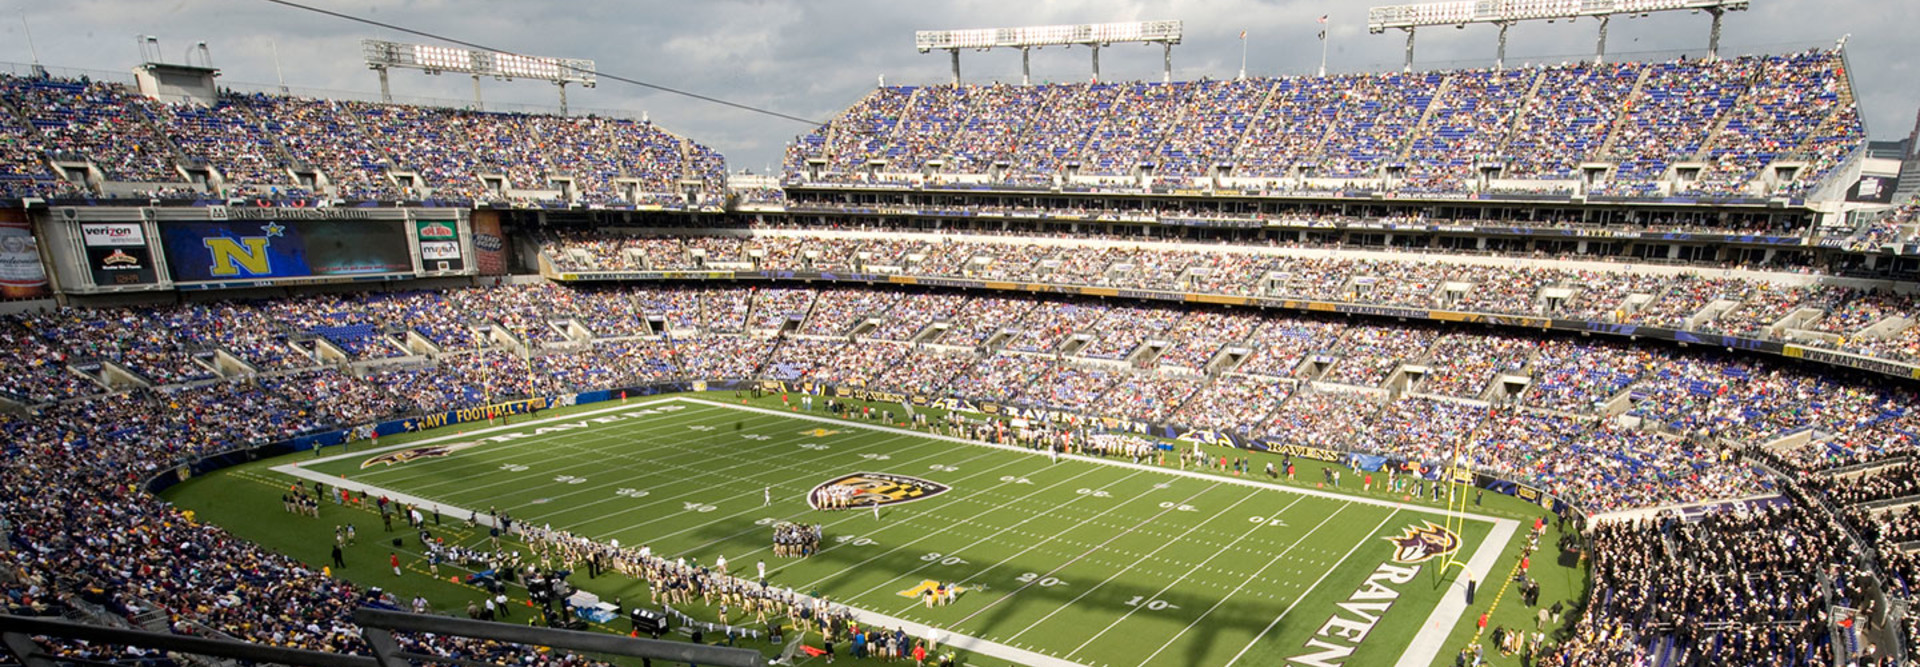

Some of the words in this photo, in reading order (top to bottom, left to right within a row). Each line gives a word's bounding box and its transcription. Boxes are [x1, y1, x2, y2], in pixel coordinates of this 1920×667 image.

[273, 206, 309, 219] Bank
[313, 207, 371, 220] Stadium
[85, 226, 131, 236] verizon
[204, 236, 271, 277] N
[1802, 349, 1914, 378] WWW.NAVYSPORTS.COM
[1267, 441, 1338, 462] RAVENS
[1016, 572, 1060, 587] 20
[1125, 595, 1169, 611] 10
